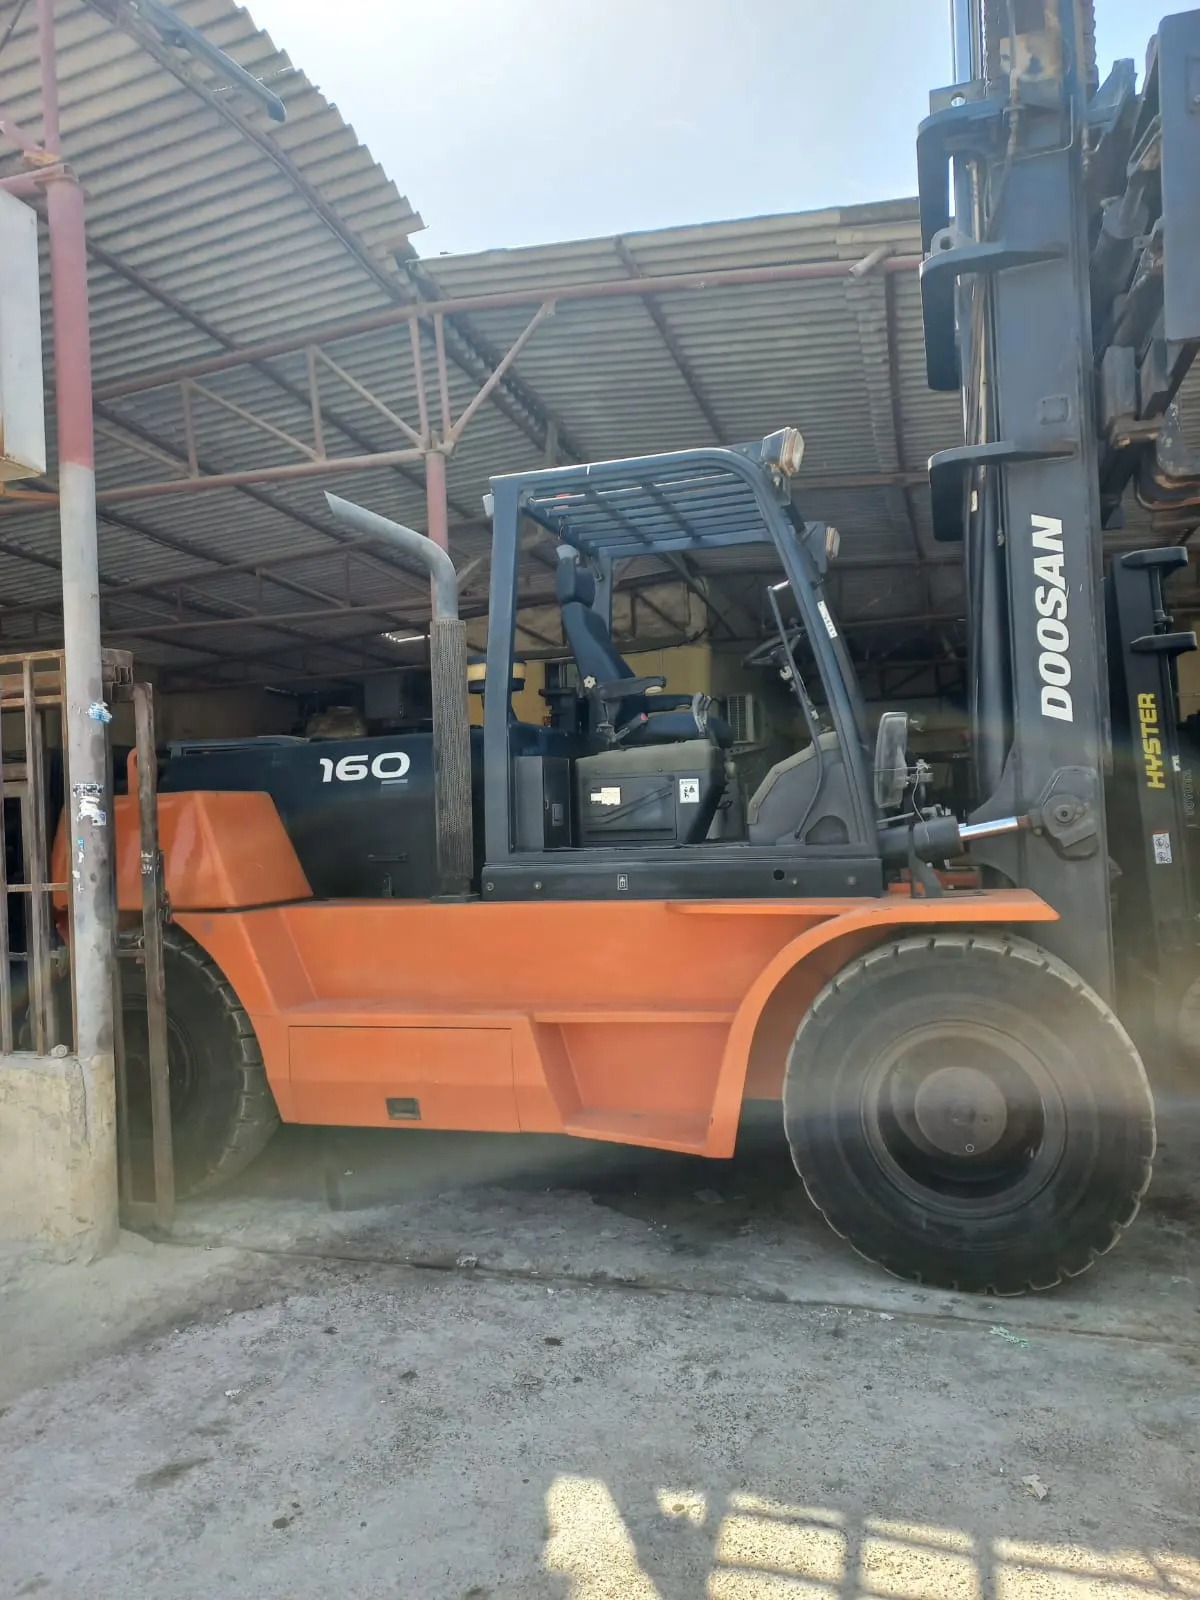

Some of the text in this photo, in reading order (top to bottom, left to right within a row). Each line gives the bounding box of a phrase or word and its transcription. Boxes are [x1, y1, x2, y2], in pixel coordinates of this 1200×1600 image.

[1031, 514, 1073, 722] DOOSAN
[319, 751, 411, 783] 160
[1138, 693, 1165, 788] HYSTER
